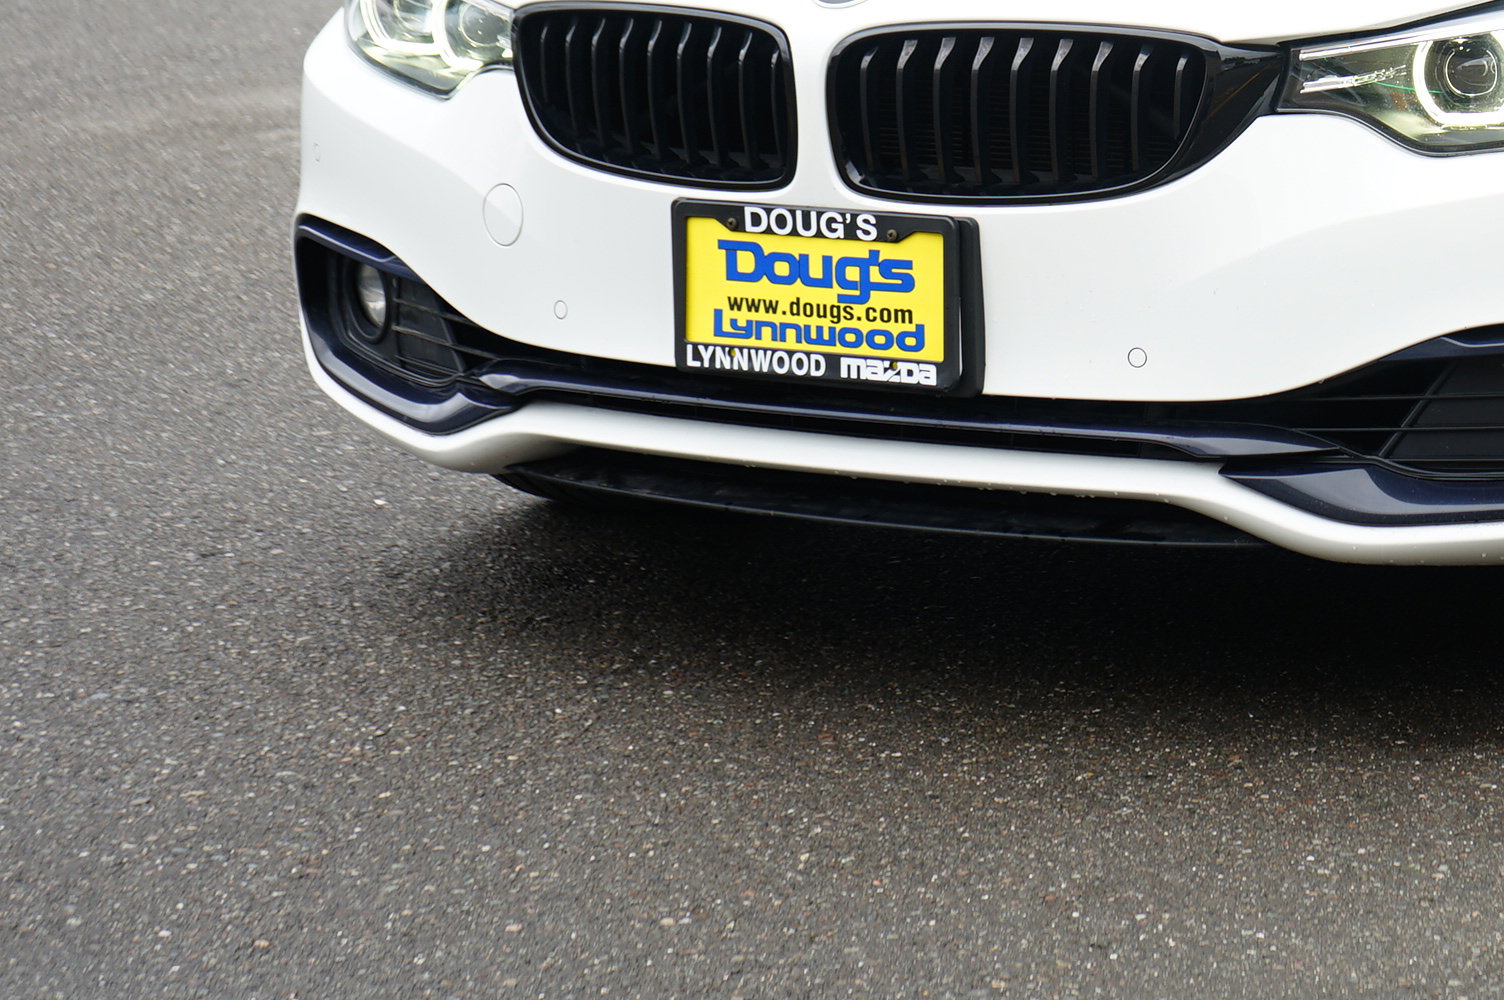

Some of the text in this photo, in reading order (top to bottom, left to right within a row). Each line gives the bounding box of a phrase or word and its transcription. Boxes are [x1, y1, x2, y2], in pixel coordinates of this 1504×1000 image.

[743, 205, 878, 241] DOUG'S
[726, 296, 914, 325] www.dougs.com
[713, 309, 926, 353] Lynnwood
[686, 344, 938, 387] LYNNWOOD mazda
